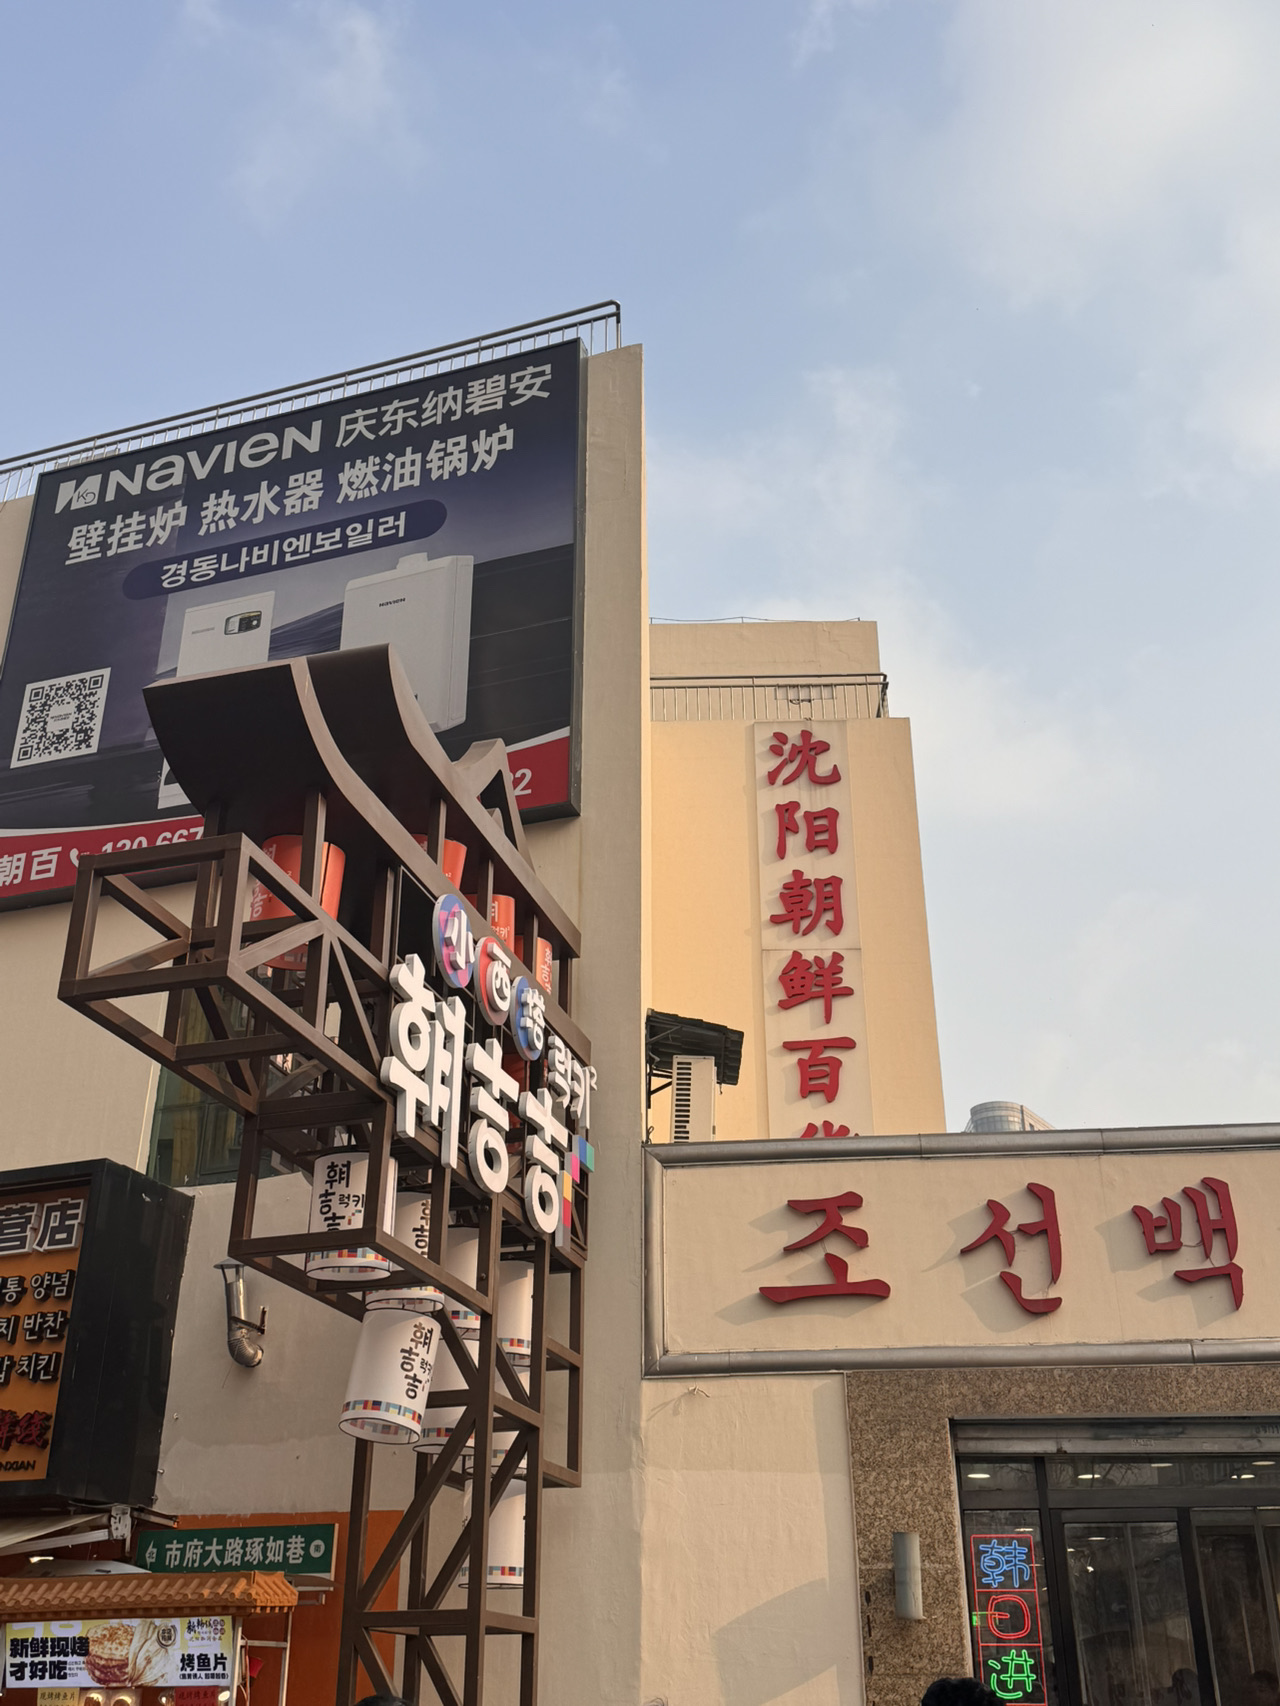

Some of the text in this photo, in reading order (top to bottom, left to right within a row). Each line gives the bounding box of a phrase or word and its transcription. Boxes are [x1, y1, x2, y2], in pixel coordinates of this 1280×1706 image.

[335, 364, 552, 447] 庆东纳碧安
[65, 423, 514, 565] 壁挂炉 热水器 燃油锅炉
[161, 511, 406, 588] 경동나비엔보일러
[767, 730, 858, 1138] 沈阳朝鲜百
[31, 1271, 70, 1300] 양념
[23, 1311, 65, 1341] 반찬
[17, 1352, 57, 1381] 치킨
[165, 1535, 306, 1569] 市府大路琢如巷
[9, 1636, 90, 1658] 新鲜现烤
[9, 1660, 68, 1681] 才好吃
[180, 1653, 228, 1672] 烤鱼片
